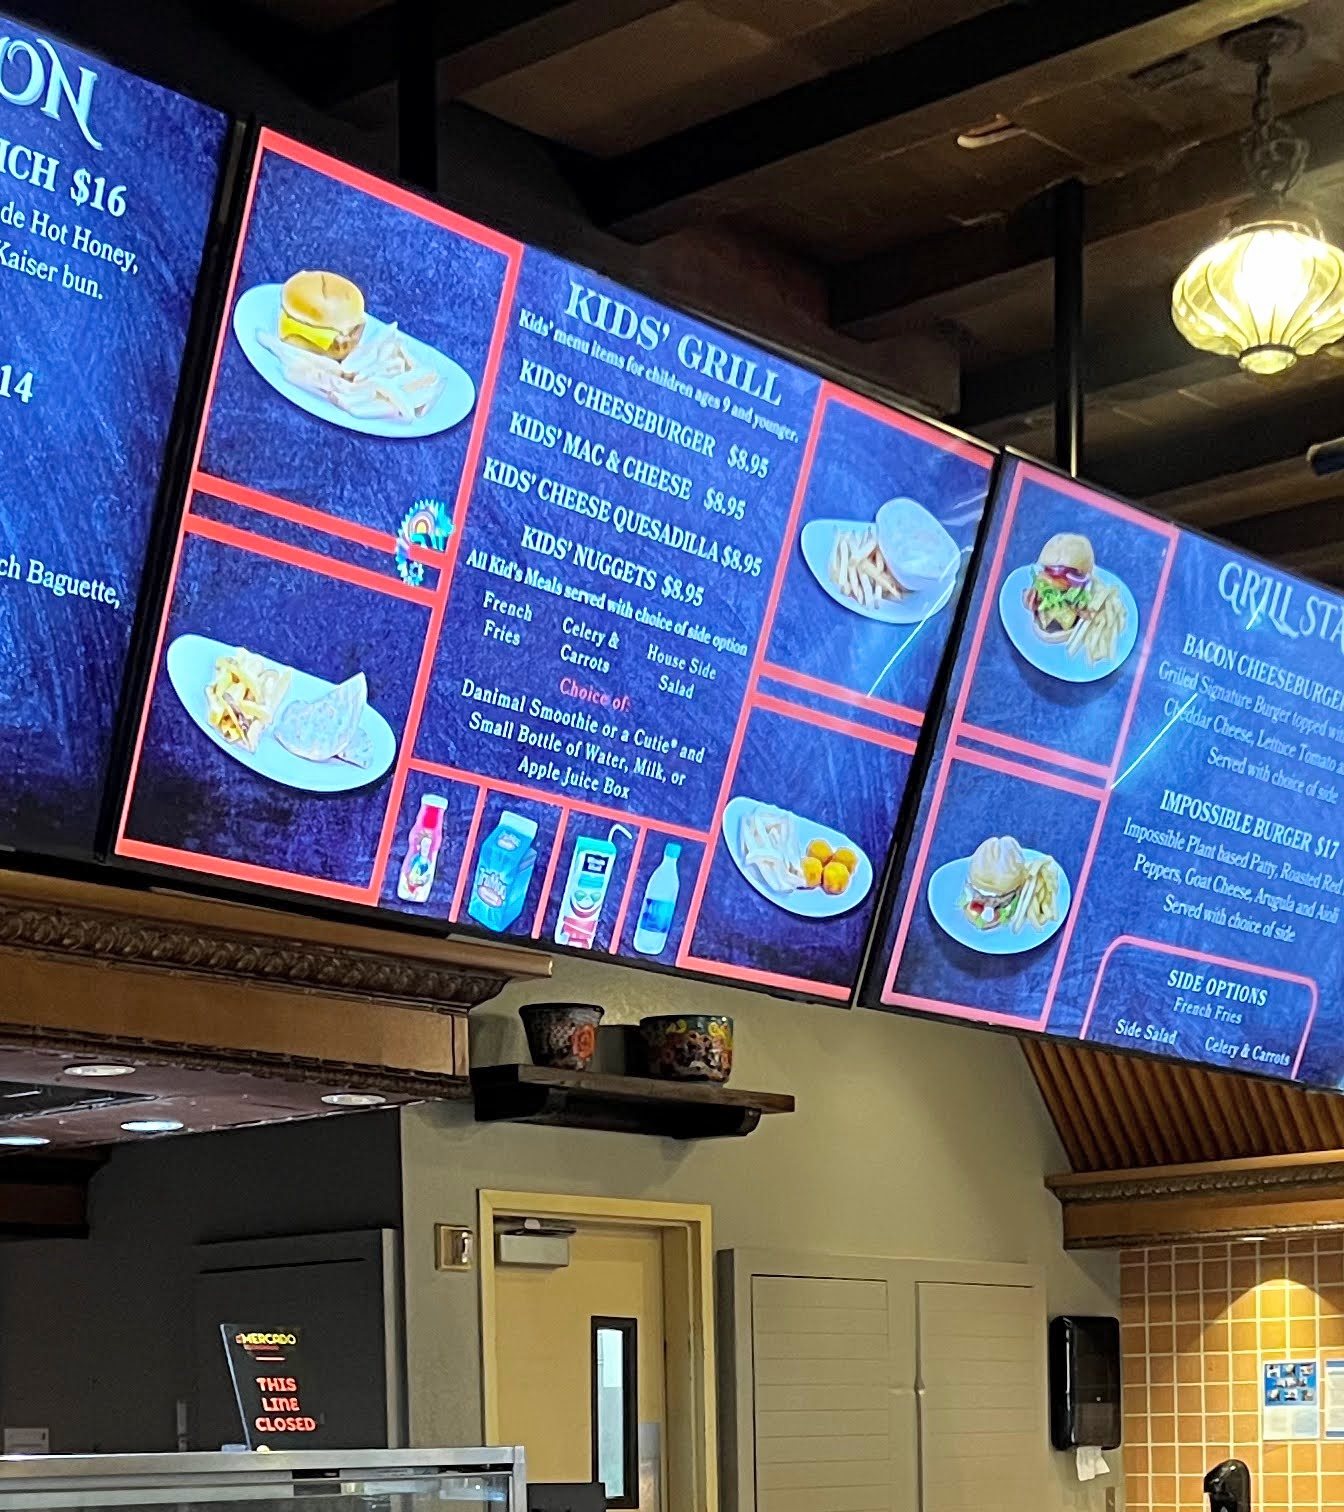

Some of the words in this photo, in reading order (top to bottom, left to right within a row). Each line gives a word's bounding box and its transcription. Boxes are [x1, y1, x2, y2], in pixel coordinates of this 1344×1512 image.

[70, 168, 127, 217] $16
[29, 209, 68, 245] Hot
[71, 224, 138, 275] Honey,
[62, 263, 103, 300] bun.
[563, 279, 670, 351] KIDS'
[677, 334, 782, 406] GRILL
[519, 357, 573, 398] KIDS'
[573, 381, 716, 458] CHEESEBURGER
[727, 443, 769, 479] $8.95
[509, 411, 563, 448] KIDS'
[562, 431, 605, 467] MAC
[605, 449, 621, 474] &
[622, 456, 693, 500] CHEESE
[703, 487, 746, 521] $8.95
[482, 456, 537, 493] KIDS'
[537, 477, 612, 523] CHEESE
[612, 505, 719, 563] QUESADILLA
[720, 545, 763, 577] $8.95
[26, 558, 120, 610] Baguette,
[520, 524, 573, 560] KIDS'
[572, 543, 657, 591] NUGGETS
[661, 574, 705, 607] $8.95
[465, 547, 489, 571] All
[487, 553, 524, 583] Kid's
[523, 566, 563, 596] Meals
[563, 585, 607, 610] served
[607, 597, 634, 619] with
[634, 606, 673, 632] choice
[673, 620, 690, 637] of
[686, 624, 712, 645] side
[712, 635, 748, 657] option
[483, 590, 533, 622] French
[1217, 561, 1300, 638] GRILL
[483, 618, 521, 646] Fries
[562, 616, 606, 648] Celery
[607, 631, 620, 650] &
[560, 643, 610, 674] Carrots
[646, 642, 686, 671] House
[688, 657, 716, 680] Side
[1181, 633, 1239, 671] BACON
[559, 677, 611, 707] Choice
[658, 674, 695, 700] Salad
[461, 678, 527, 713] Danimal
[528, 697, 599, 734] Smoothie
[601, 723, 619, 739] or
[620, 729, 630, 743] a
[679, 746, 706, 764] and
[468, 710, 515, 740] Small
[517, 723, 562, 753] Bottle
[565, 740, 583, 758] of
[585, 742, 629, 774] Water,
[633, 756, 667, 784] Milk,
[671, 772, 687, 786] or
[517, 755, 561, 781] Apple
[560, 766, 599, 792] Juice
[603, 776, 630, 800] Box
[1159, 789, 1254, 835] IMPOSSIBLE
[1251, 817, 1313, 853] BURGER
[1314, 836, 1340, 860] $17
[1167, 969, 1205, 992] SIDE
[1205, 977, 1268, 1007] OPTIONS
[1173, 996, 1212, 1019] French
[1213, 1004, 1243, 1025] Fries
[1114, 1018, 1142, 1038] Side
[1143, 1024, 1178, 1046] Salad
[1205, 1036, 1240, 1059] Celery
[1239, 1043, 1251, 1059] &
[1251, 1045, 1291, 1066] Carrots
[256, 1377, 297, 1392] THIS
[261, 1397, 300, 1412] LINE
[255, 1417, 316, 1432] CLOSED
